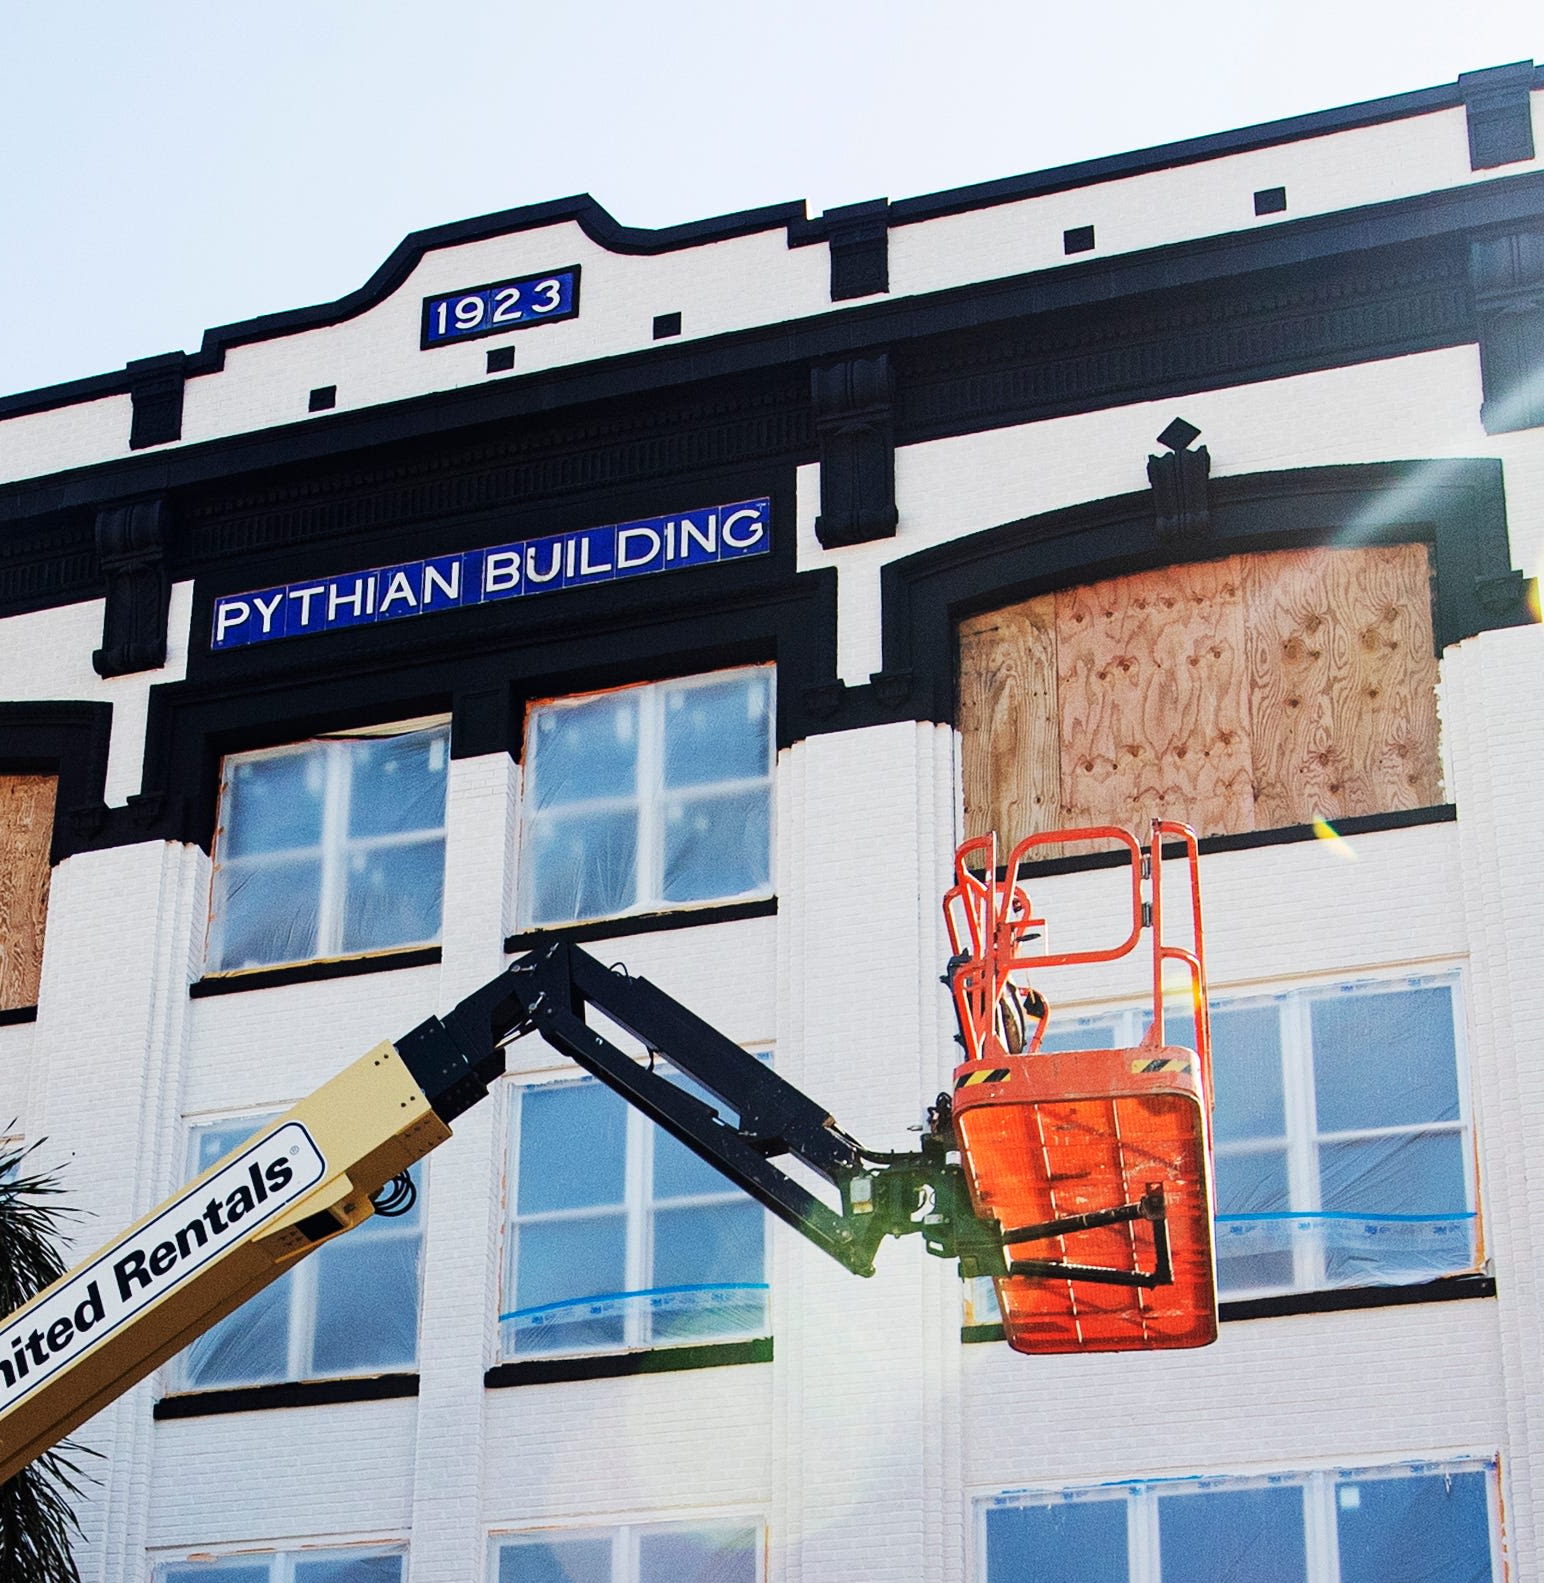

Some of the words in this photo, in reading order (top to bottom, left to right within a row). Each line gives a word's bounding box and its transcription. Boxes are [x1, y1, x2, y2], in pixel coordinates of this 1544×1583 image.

[436, 279, 562, 335] 1923
[215, 561, 460, 642] PYTHIAN
[485, 508, 764, 592] BUILDING
[113, 1155, 294, 1303] Rentals
